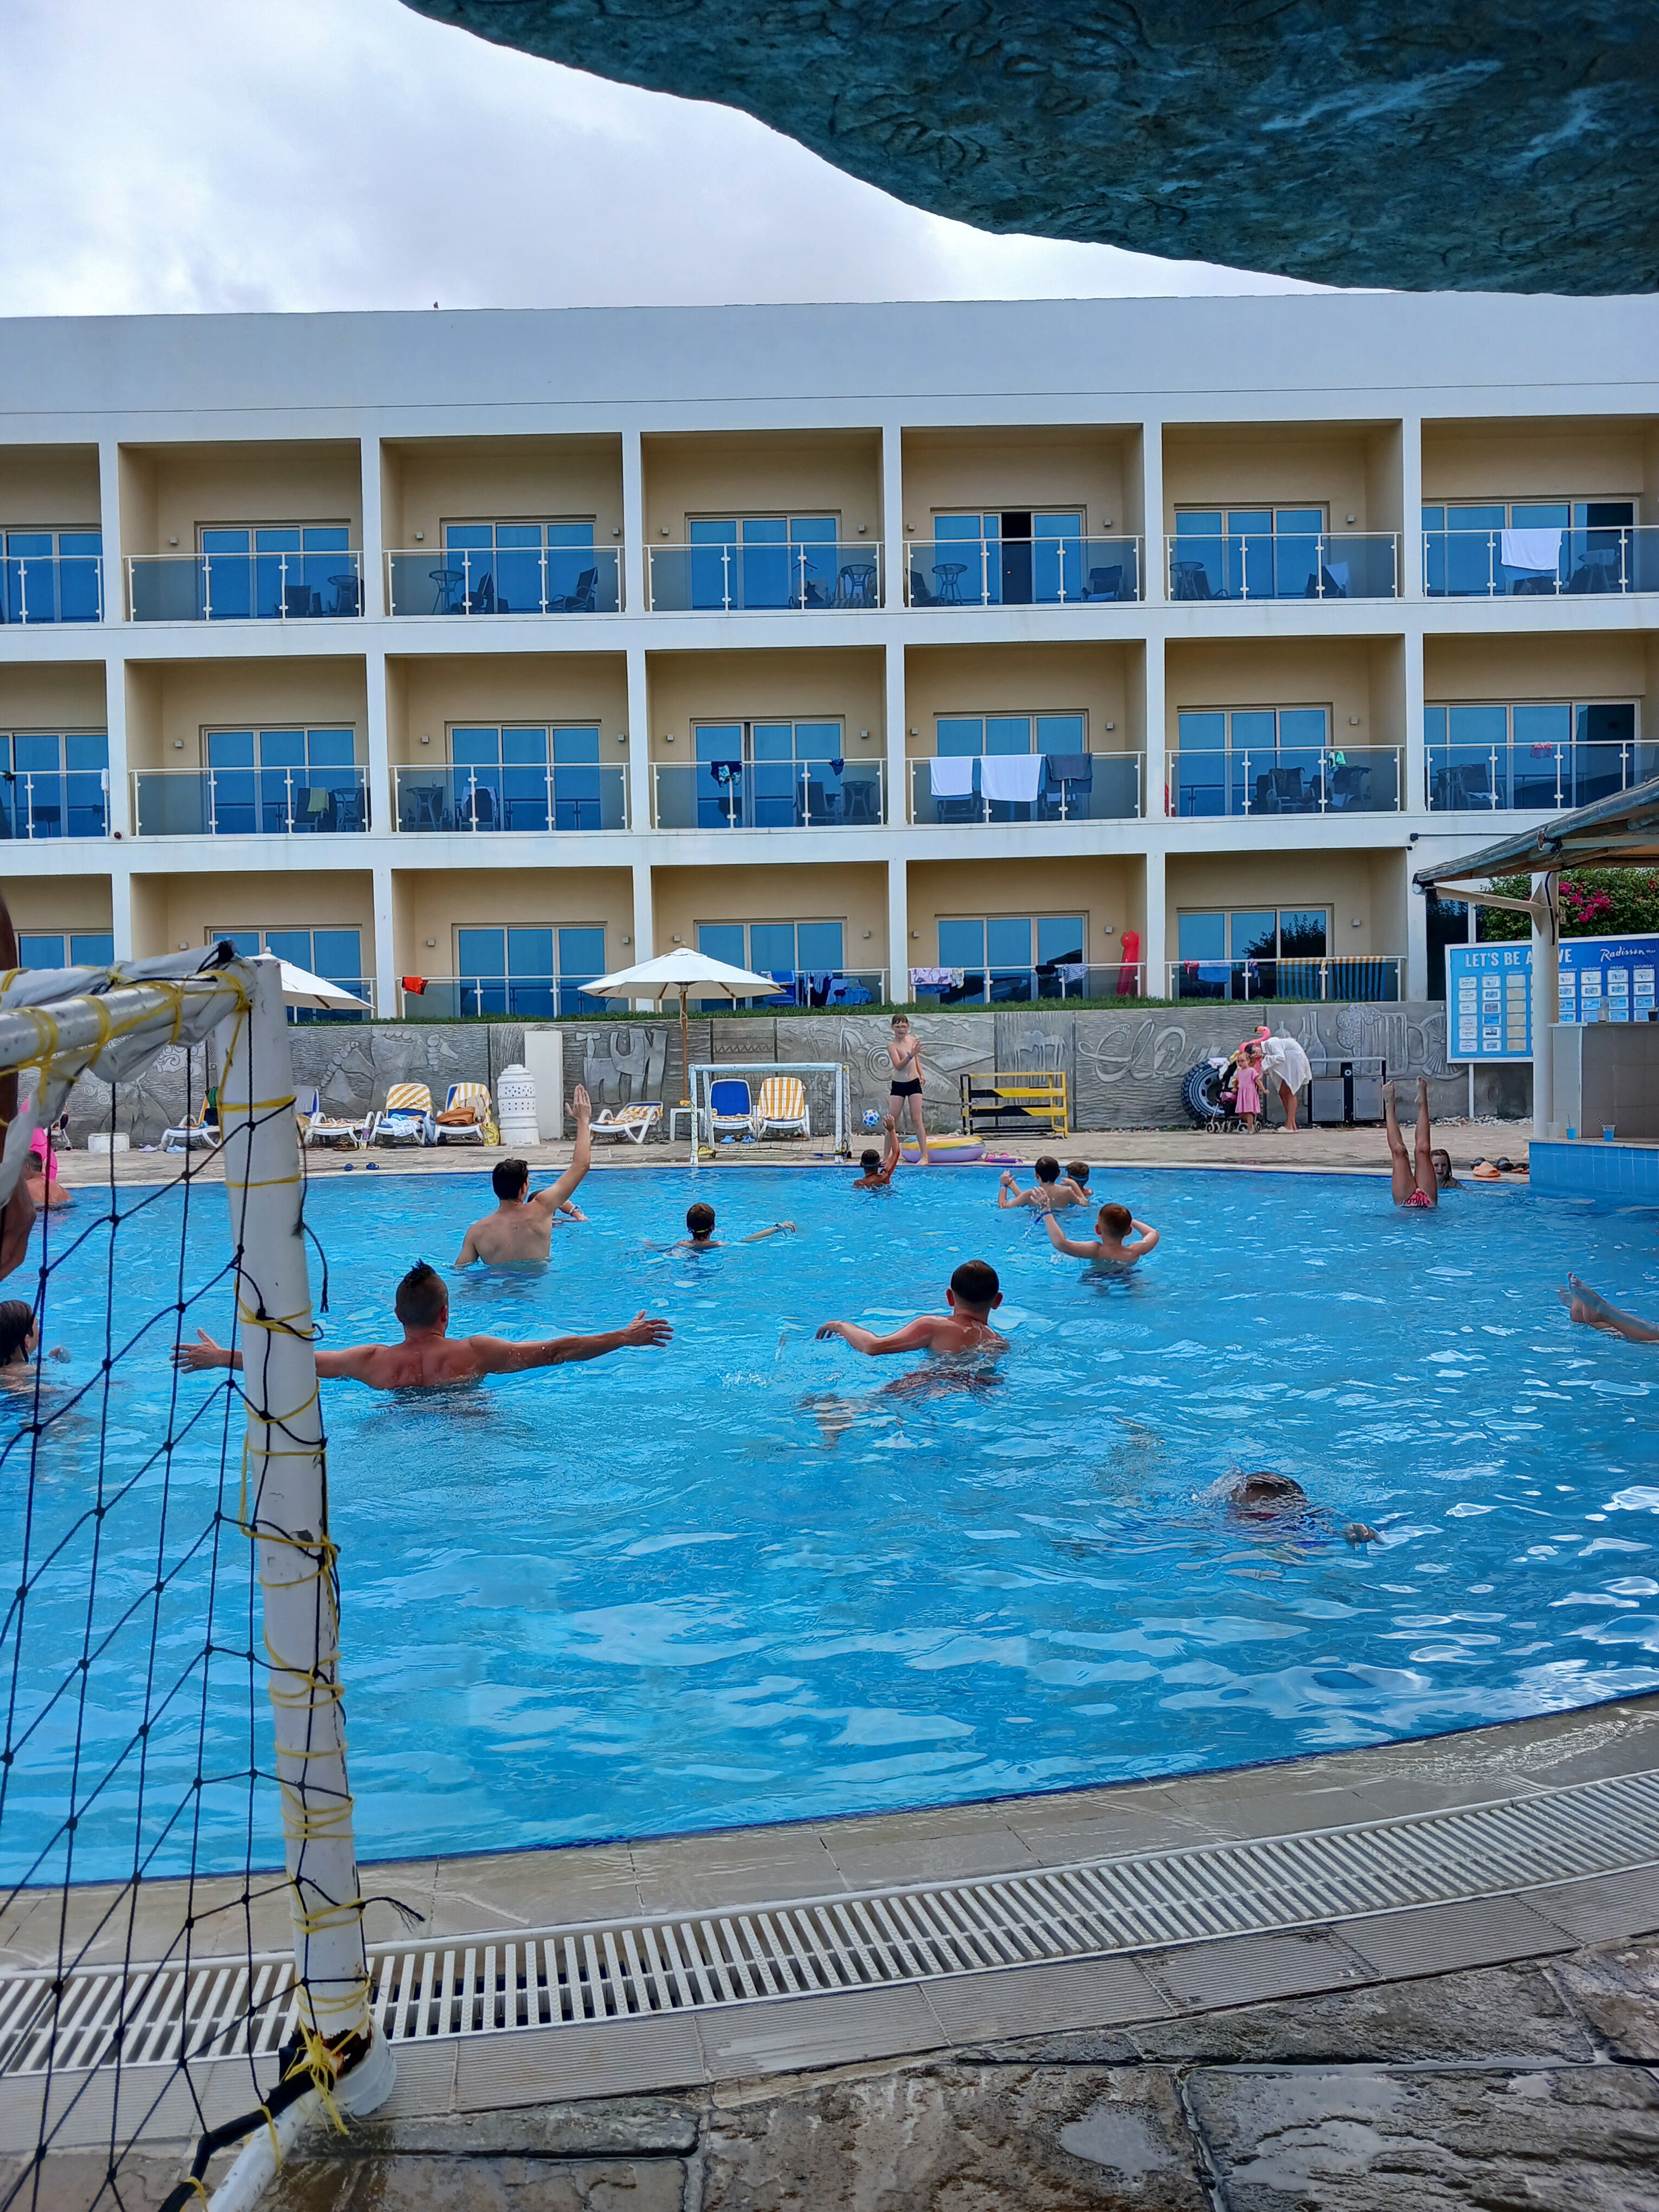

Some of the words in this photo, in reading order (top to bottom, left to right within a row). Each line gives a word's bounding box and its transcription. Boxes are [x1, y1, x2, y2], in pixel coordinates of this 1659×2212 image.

[1465, 952, 1500, 968] LET'S
[1503, 951, 1521, 966] BE
[1600, 946, 1645, 962] Radisson
